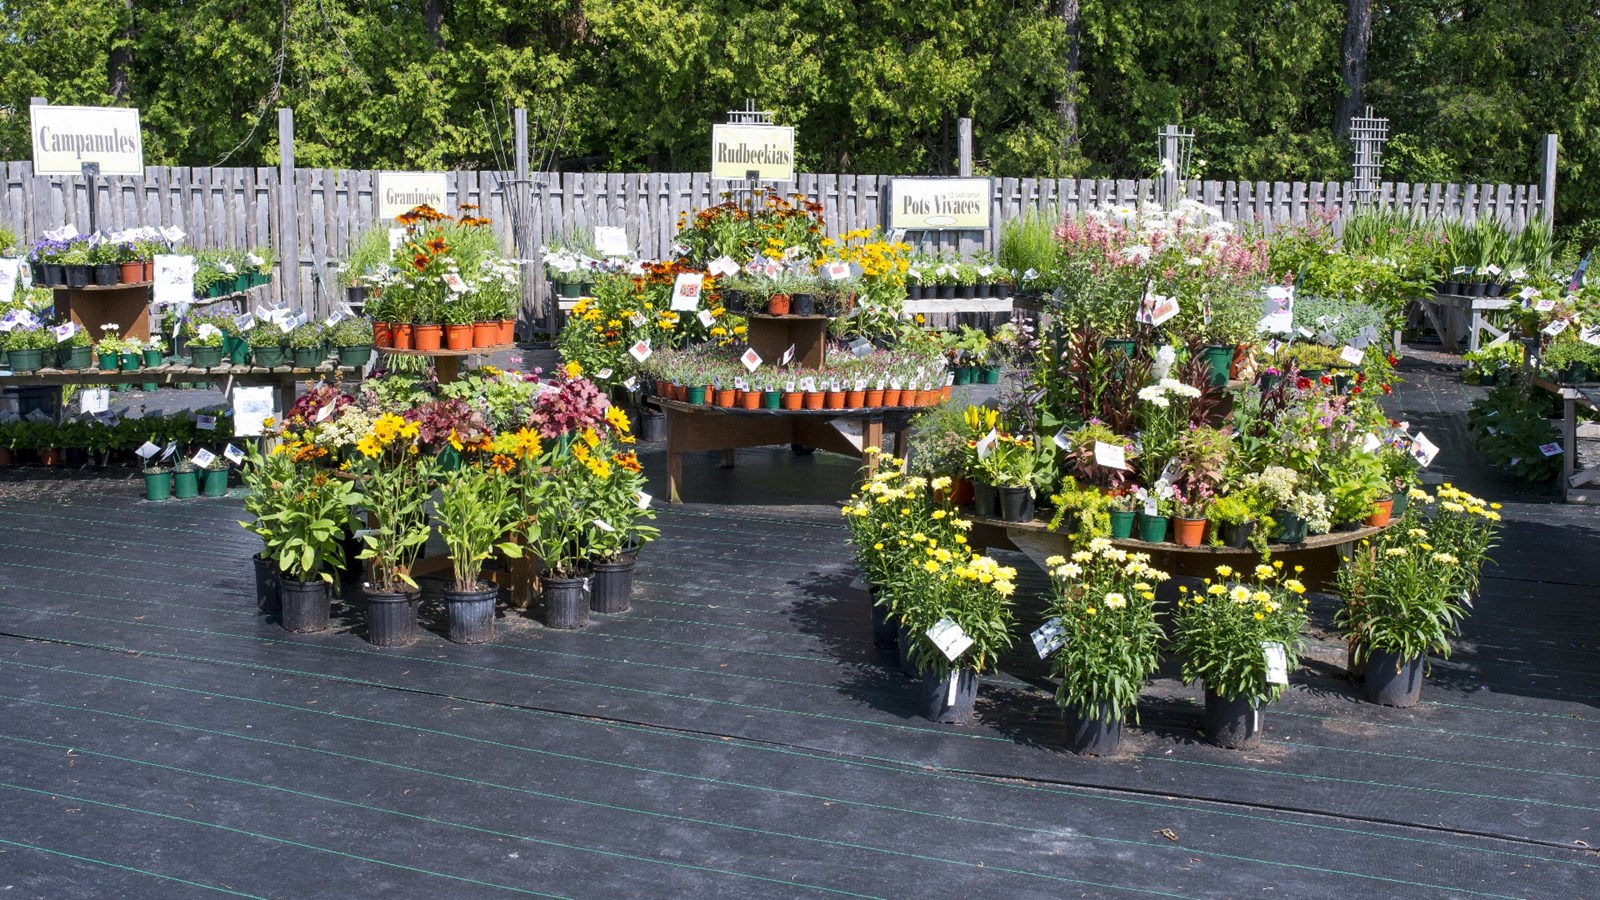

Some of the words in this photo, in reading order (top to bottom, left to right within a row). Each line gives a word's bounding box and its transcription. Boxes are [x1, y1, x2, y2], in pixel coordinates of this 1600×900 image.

[40, 125, 136, 160] Campanules
[717, 142, 790, 165] Rudbeckias
[386, 187, 441, 205] Graminées
[902, 194, 930, 215] Pots
[933, 194, 980, 215] Vivaces
